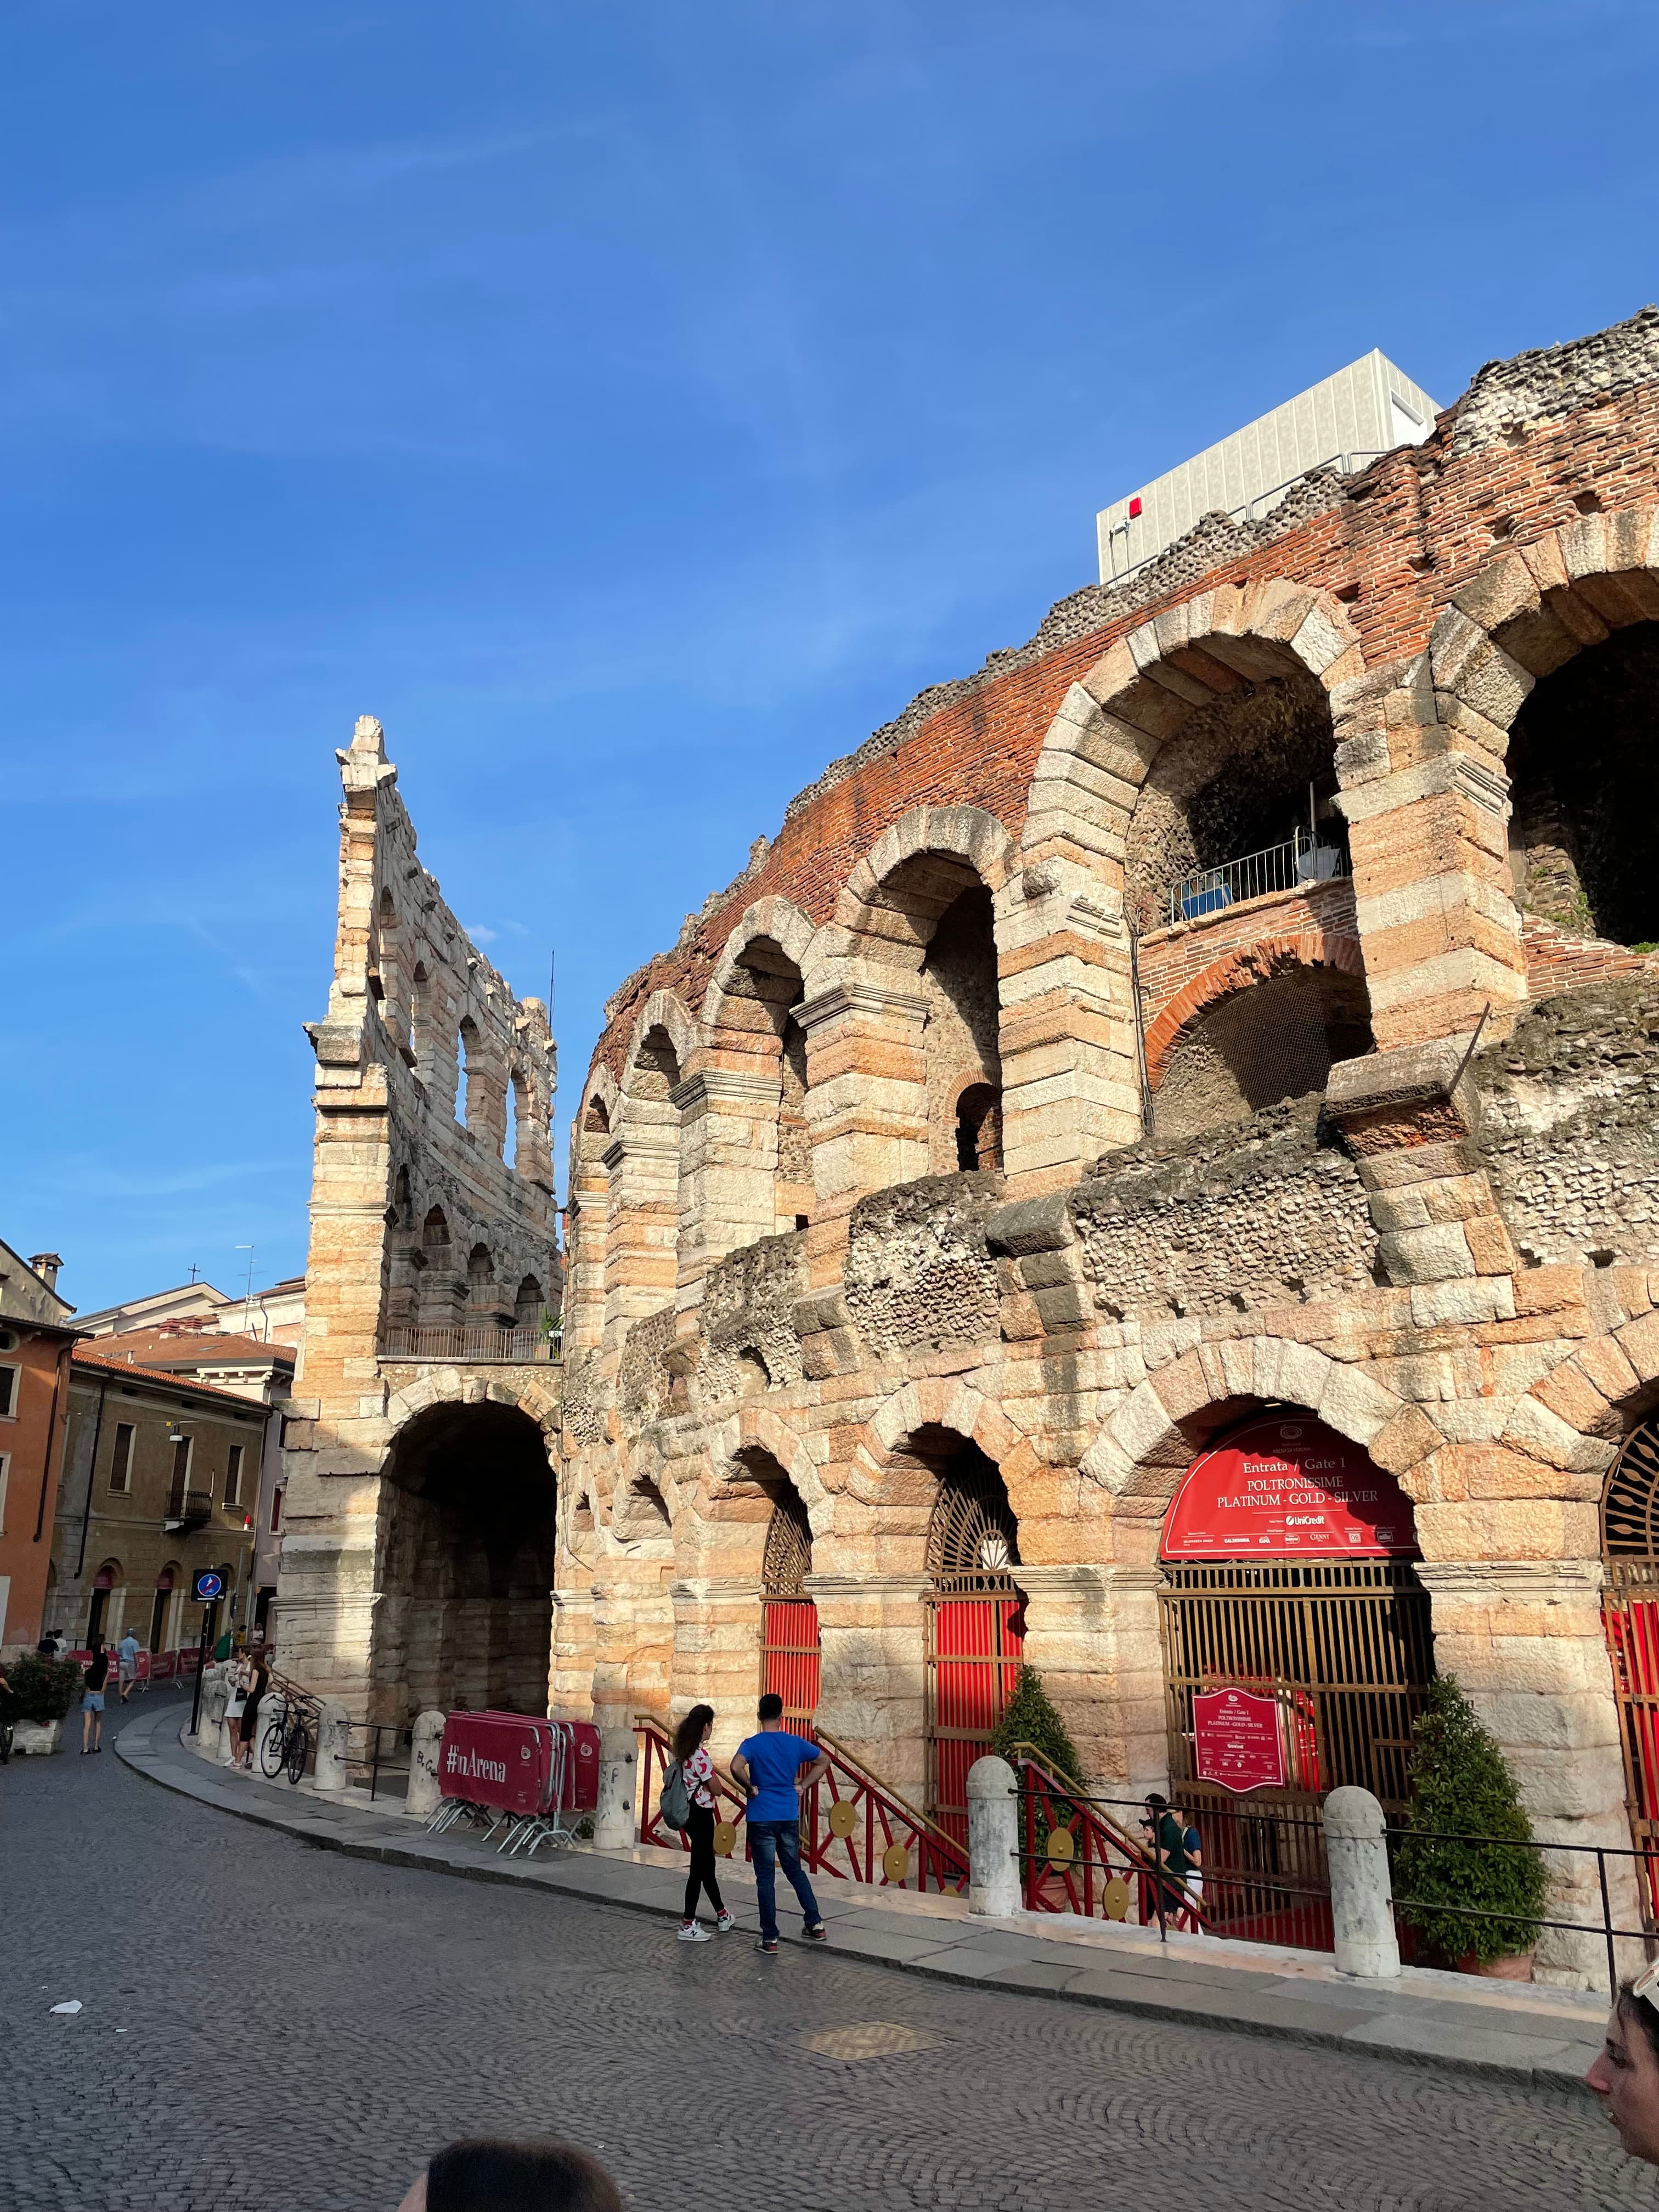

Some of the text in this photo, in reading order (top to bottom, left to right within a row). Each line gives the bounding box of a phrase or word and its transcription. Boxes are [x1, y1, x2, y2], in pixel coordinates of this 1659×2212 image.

[1243, 1457, 1346, 1474] Entrata / Gate 1
[1247, 1476, 1344, 1492] POLTRONISSIME
[1217, 1494, 1281, 1508] PLATINUM
[1289, 1492, 1325, 1504] GOLD
[1334, 1490, 1379, 1503] SILVER
[1294, 1515, 1325, 1525] UniCredit
[447, 1745, 506, 1783] #inArena
